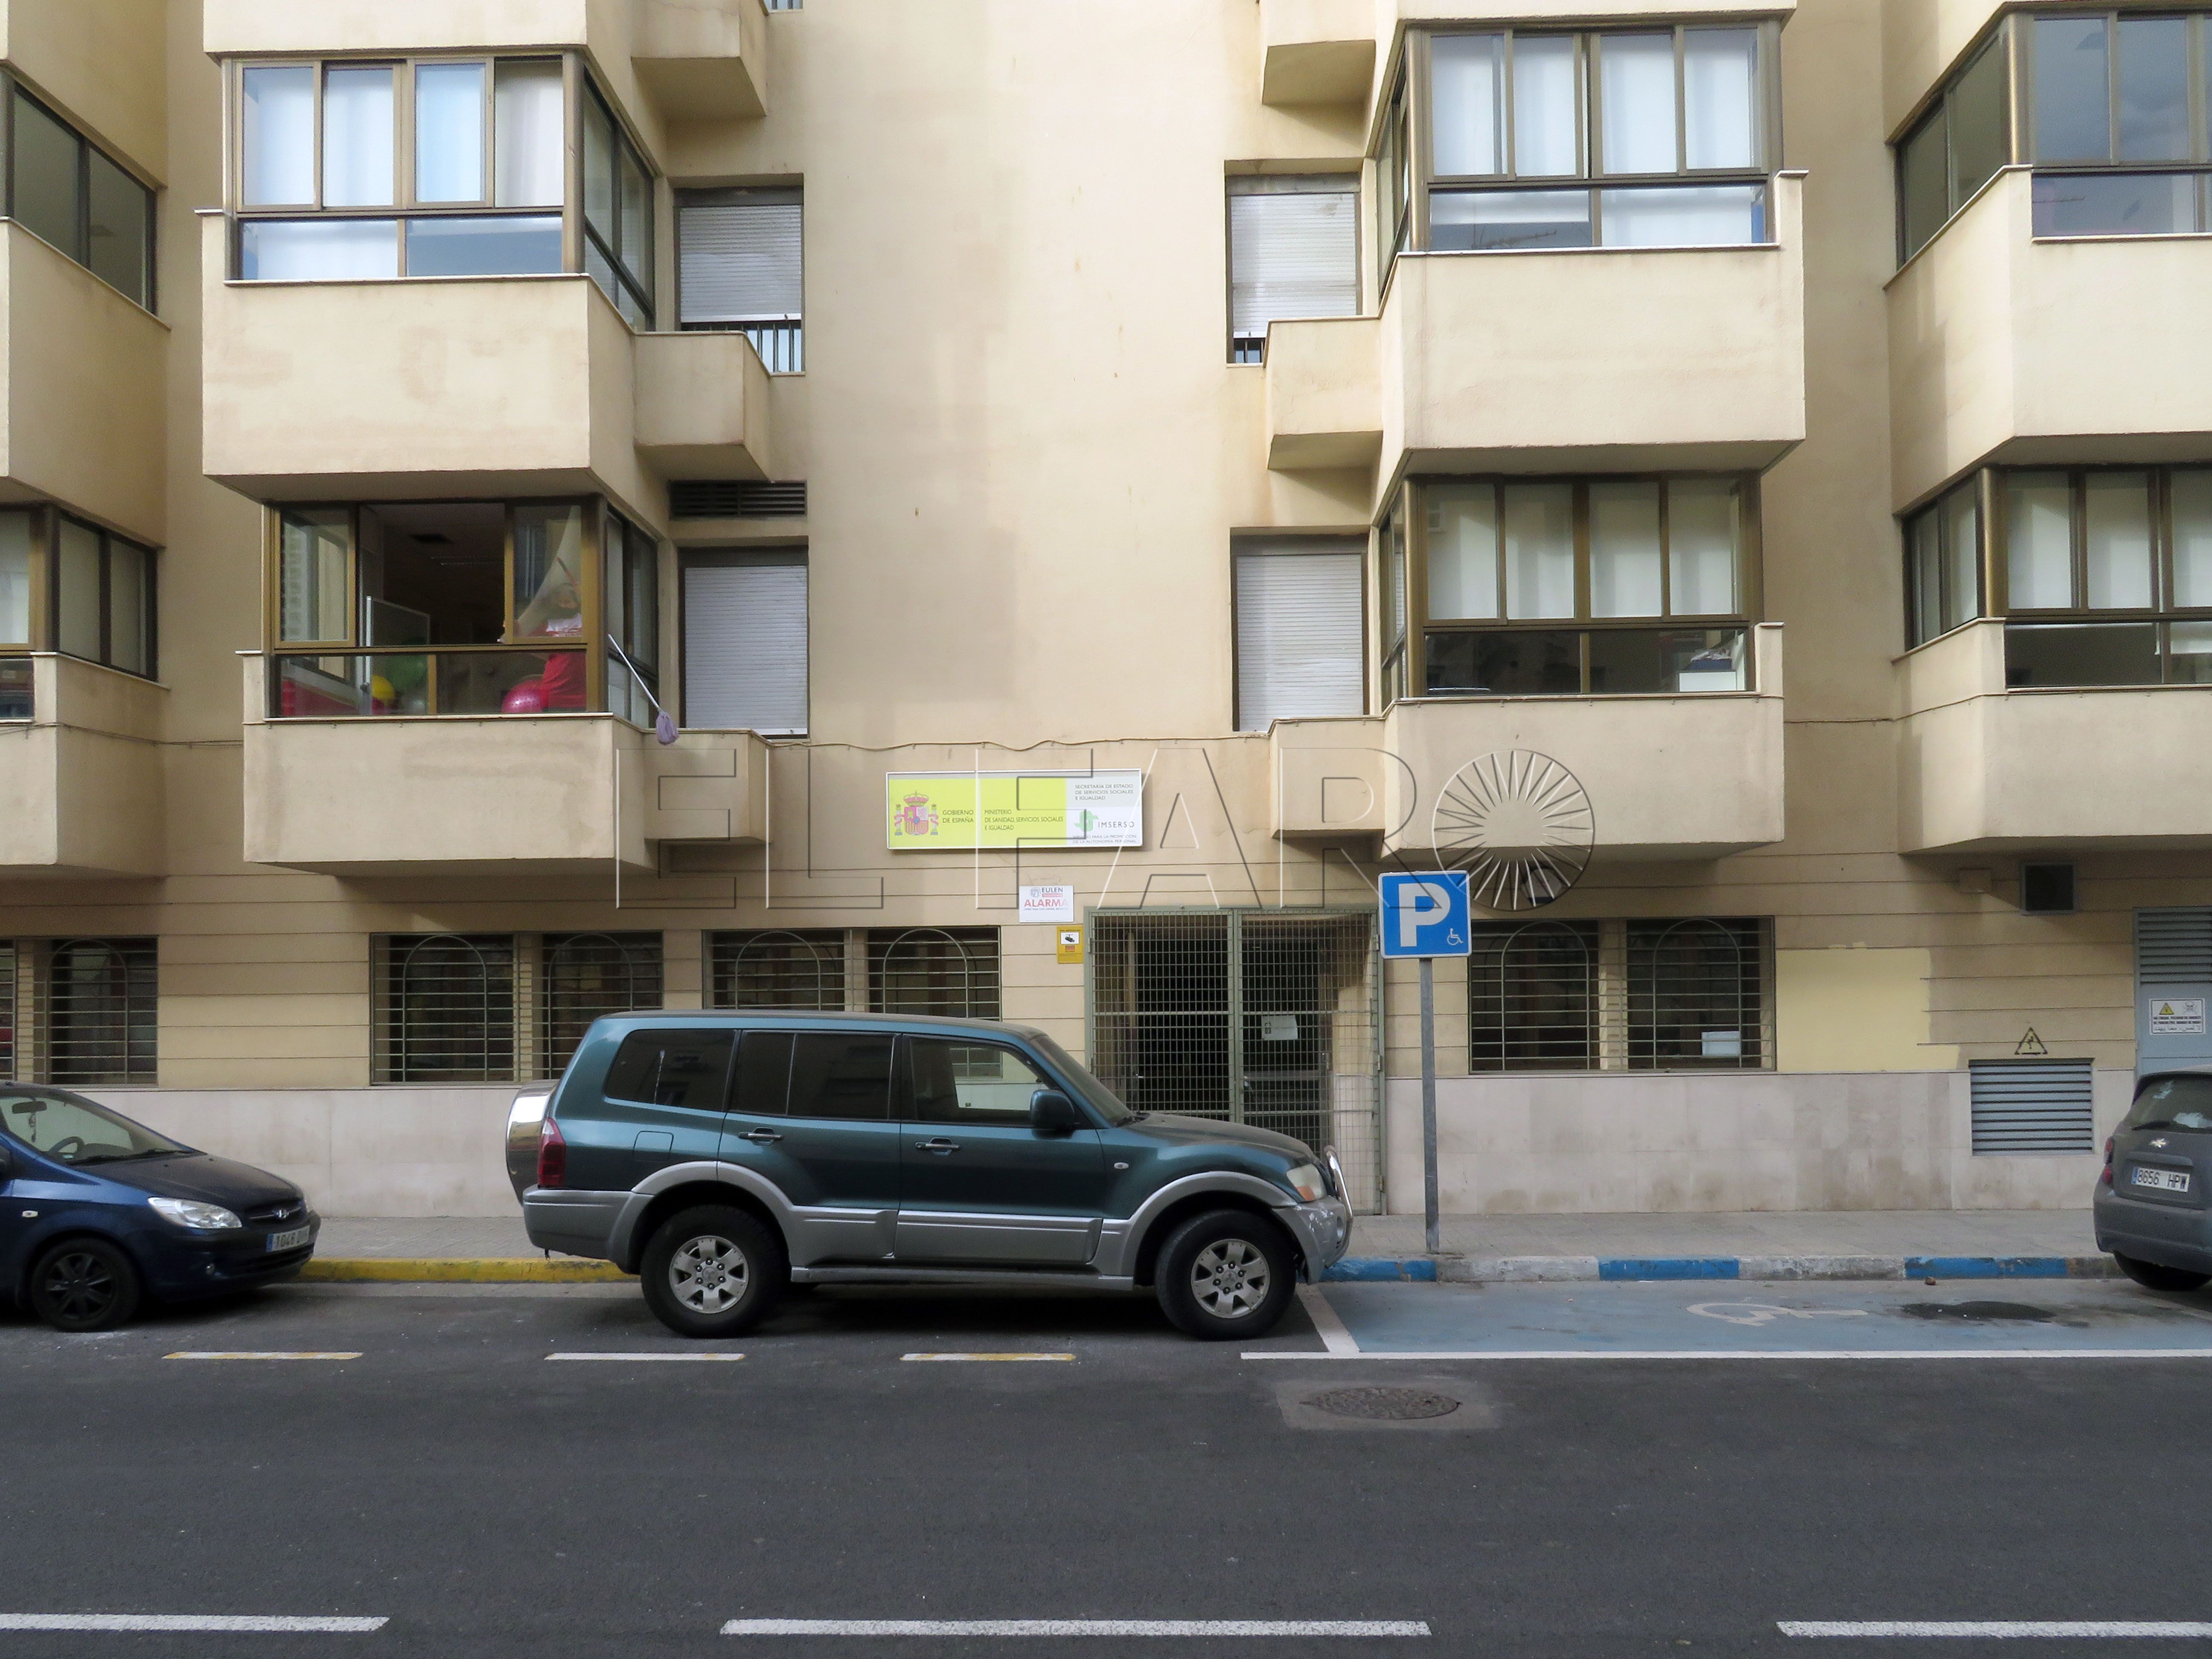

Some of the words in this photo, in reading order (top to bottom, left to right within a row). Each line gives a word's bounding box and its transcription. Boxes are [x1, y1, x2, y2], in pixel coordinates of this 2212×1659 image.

[1024, 899, 1068, 907] ALARMA
[1398, 882, 1451, 947] P
[2137, 1169, 2160, 1185] 8656
